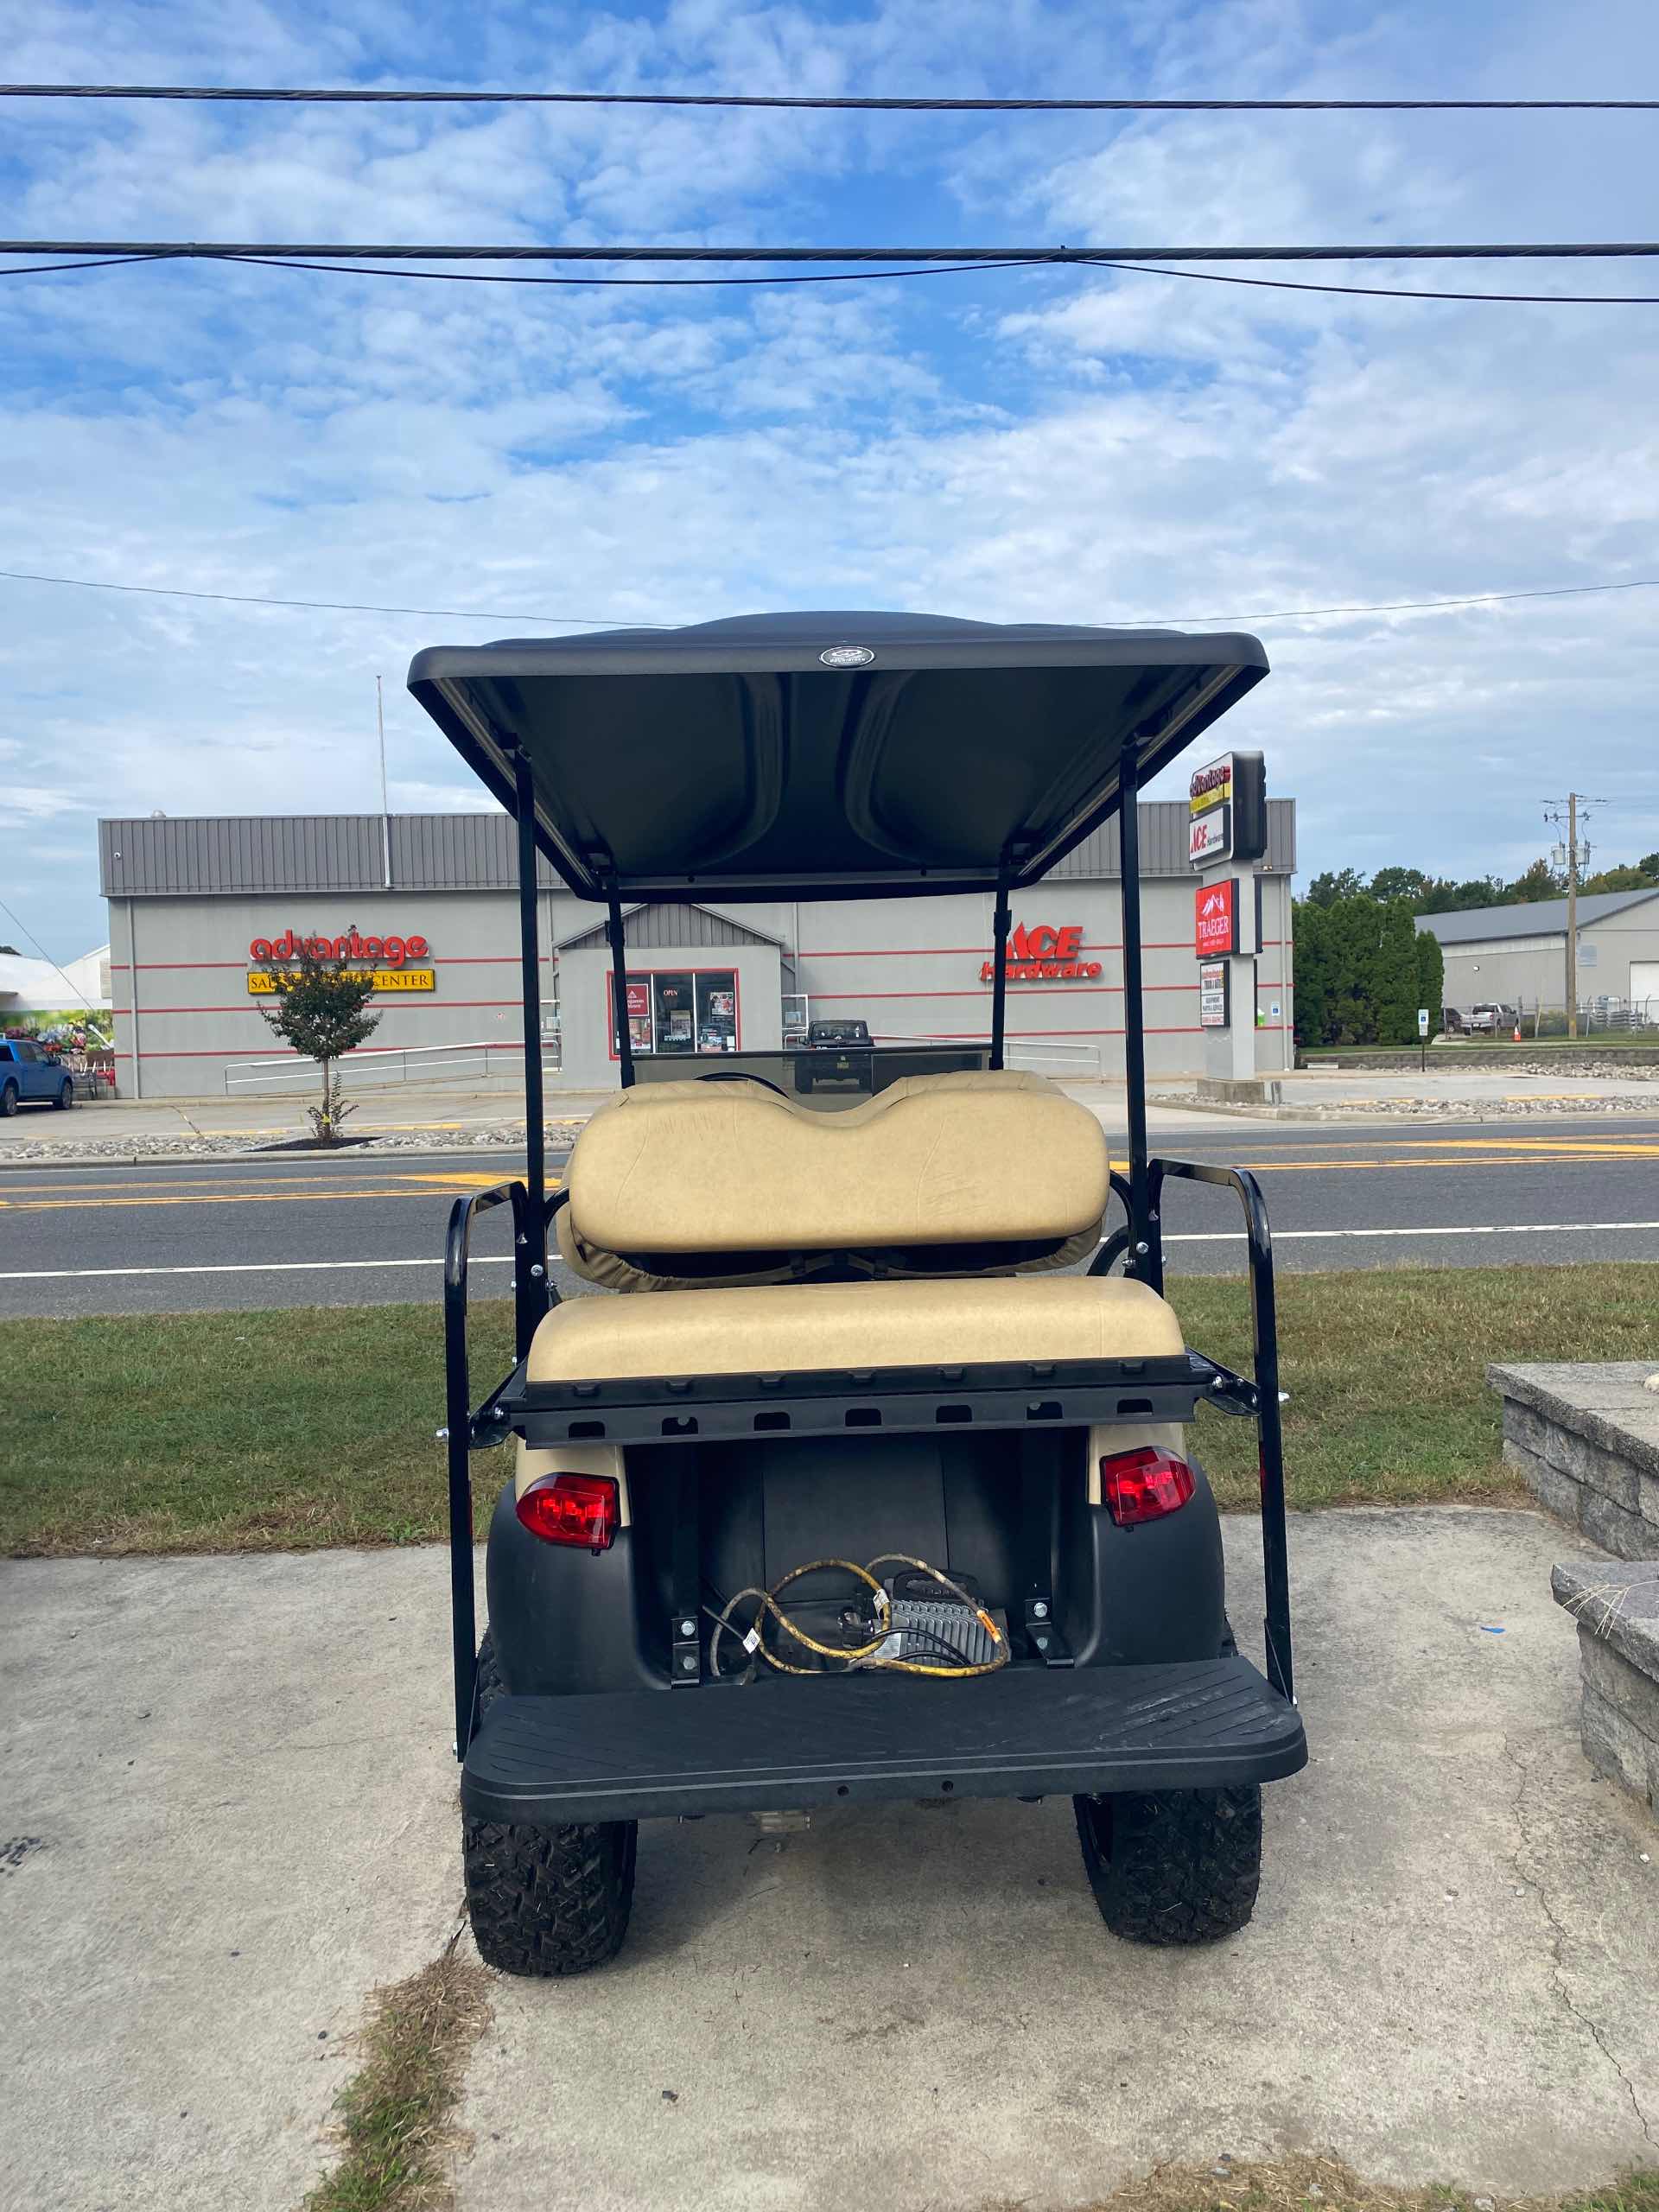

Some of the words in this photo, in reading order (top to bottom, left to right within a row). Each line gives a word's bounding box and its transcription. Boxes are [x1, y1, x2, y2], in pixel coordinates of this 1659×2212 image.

[1006, 921, 1083, 959] ACE
[1198, 916, 1229, 939] TRAEGER
[250, 929, 429, 967] advantage
